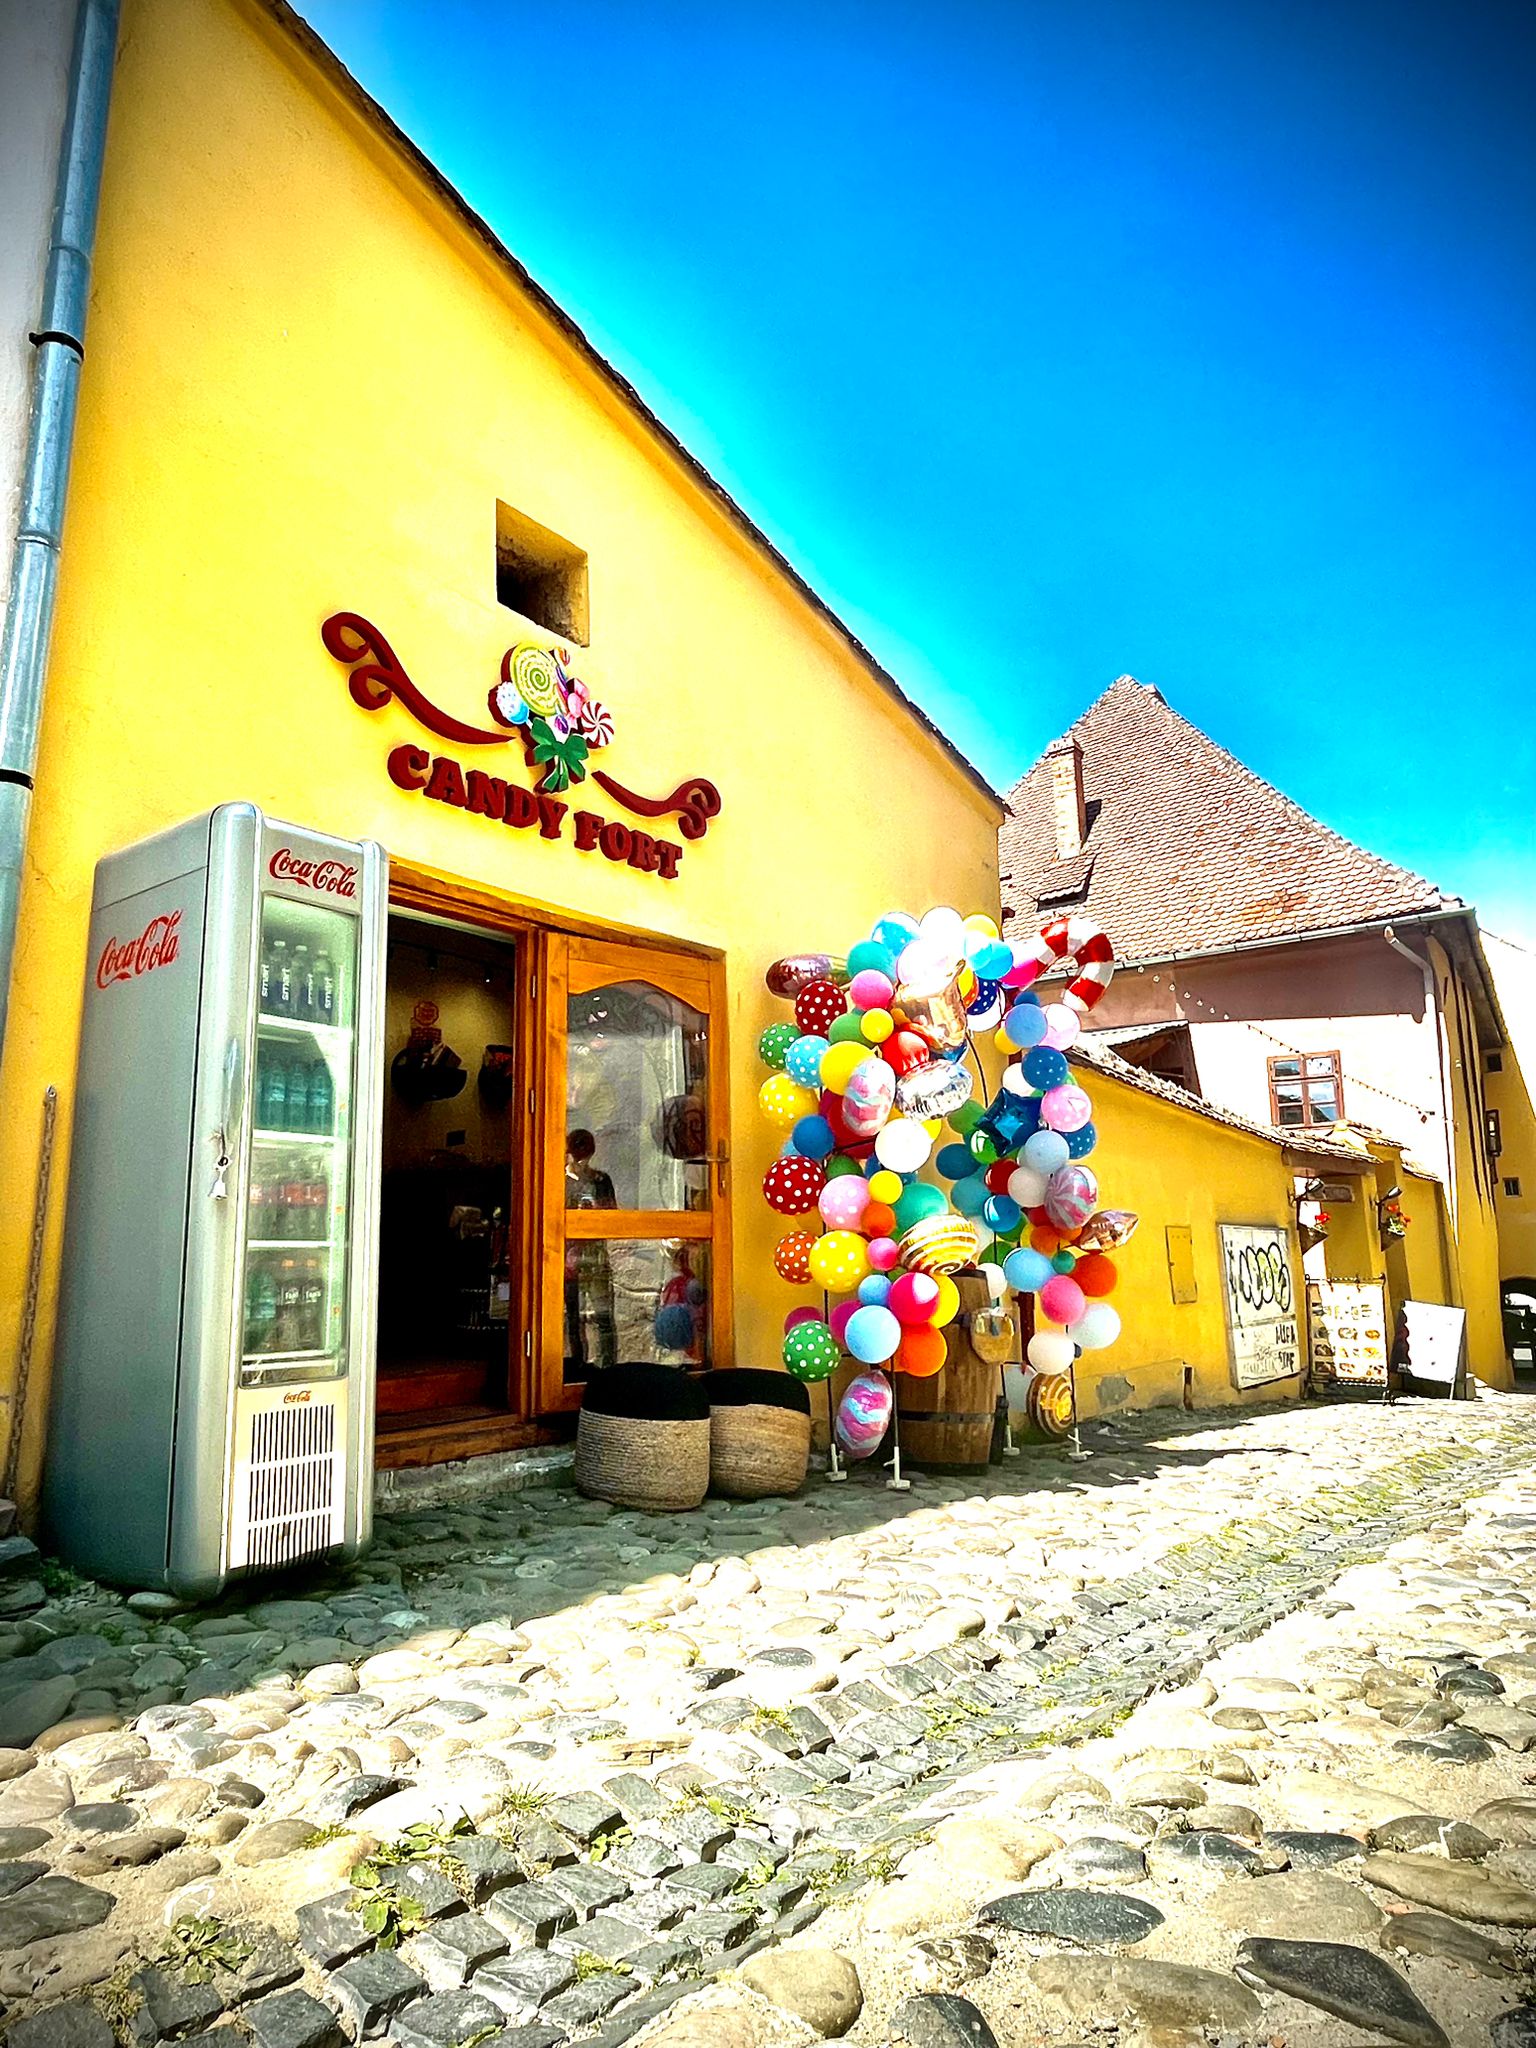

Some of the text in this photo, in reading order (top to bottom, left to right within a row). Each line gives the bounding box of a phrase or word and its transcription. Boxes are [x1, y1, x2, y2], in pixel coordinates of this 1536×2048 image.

[387, 744, 683, 880] CANDY FORT
[269, 848, 358, 897] Coca-Cola
[96, 909, 183, 989] Coca-Cola
[261, 964, 270, 997] smart
[281, 967, 291, 1001] smart
